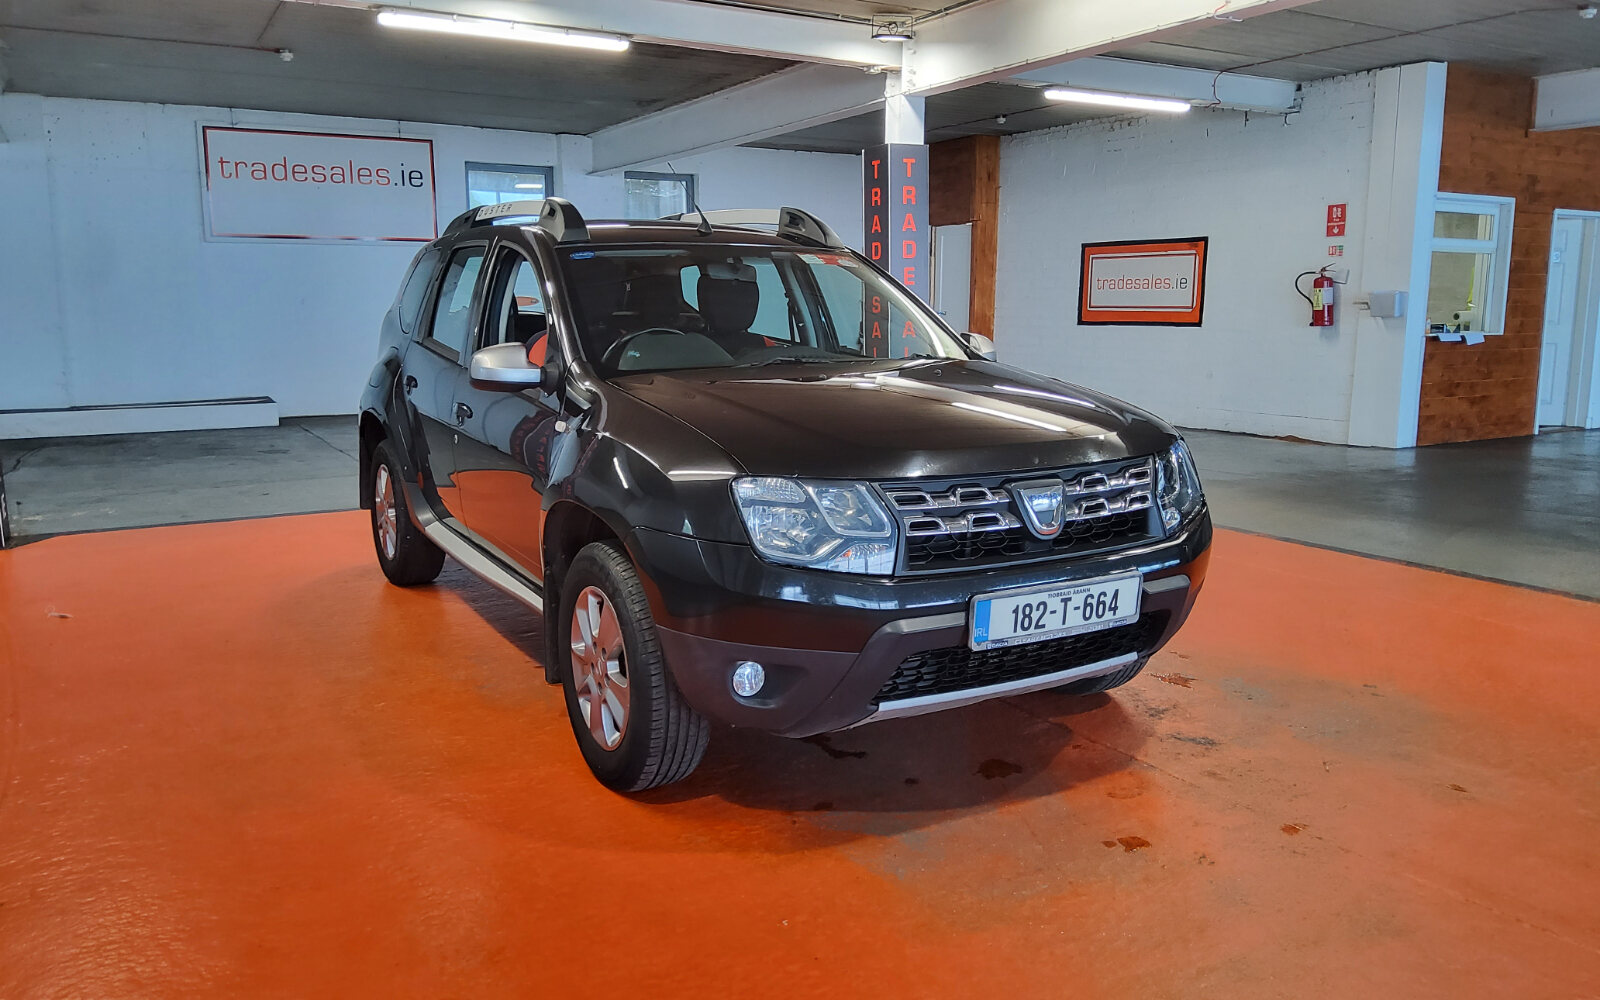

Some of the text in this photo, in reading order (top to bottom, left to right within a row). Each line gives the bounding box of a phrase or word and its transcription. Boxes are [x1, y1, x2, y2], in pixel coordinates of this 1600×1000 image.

[218, 156, 423, 188] tradesales.ie
[479, 203, 513, 218] DUSTER
[871, 159, 881, 260] TRAD
[902, 158, 916, 285] TRADE
[1097, 273, 1188, 290] tradesales.ie
[1012, 589, 1120, 633] 182-T-664
[974, 628, 988, 638] IRL
